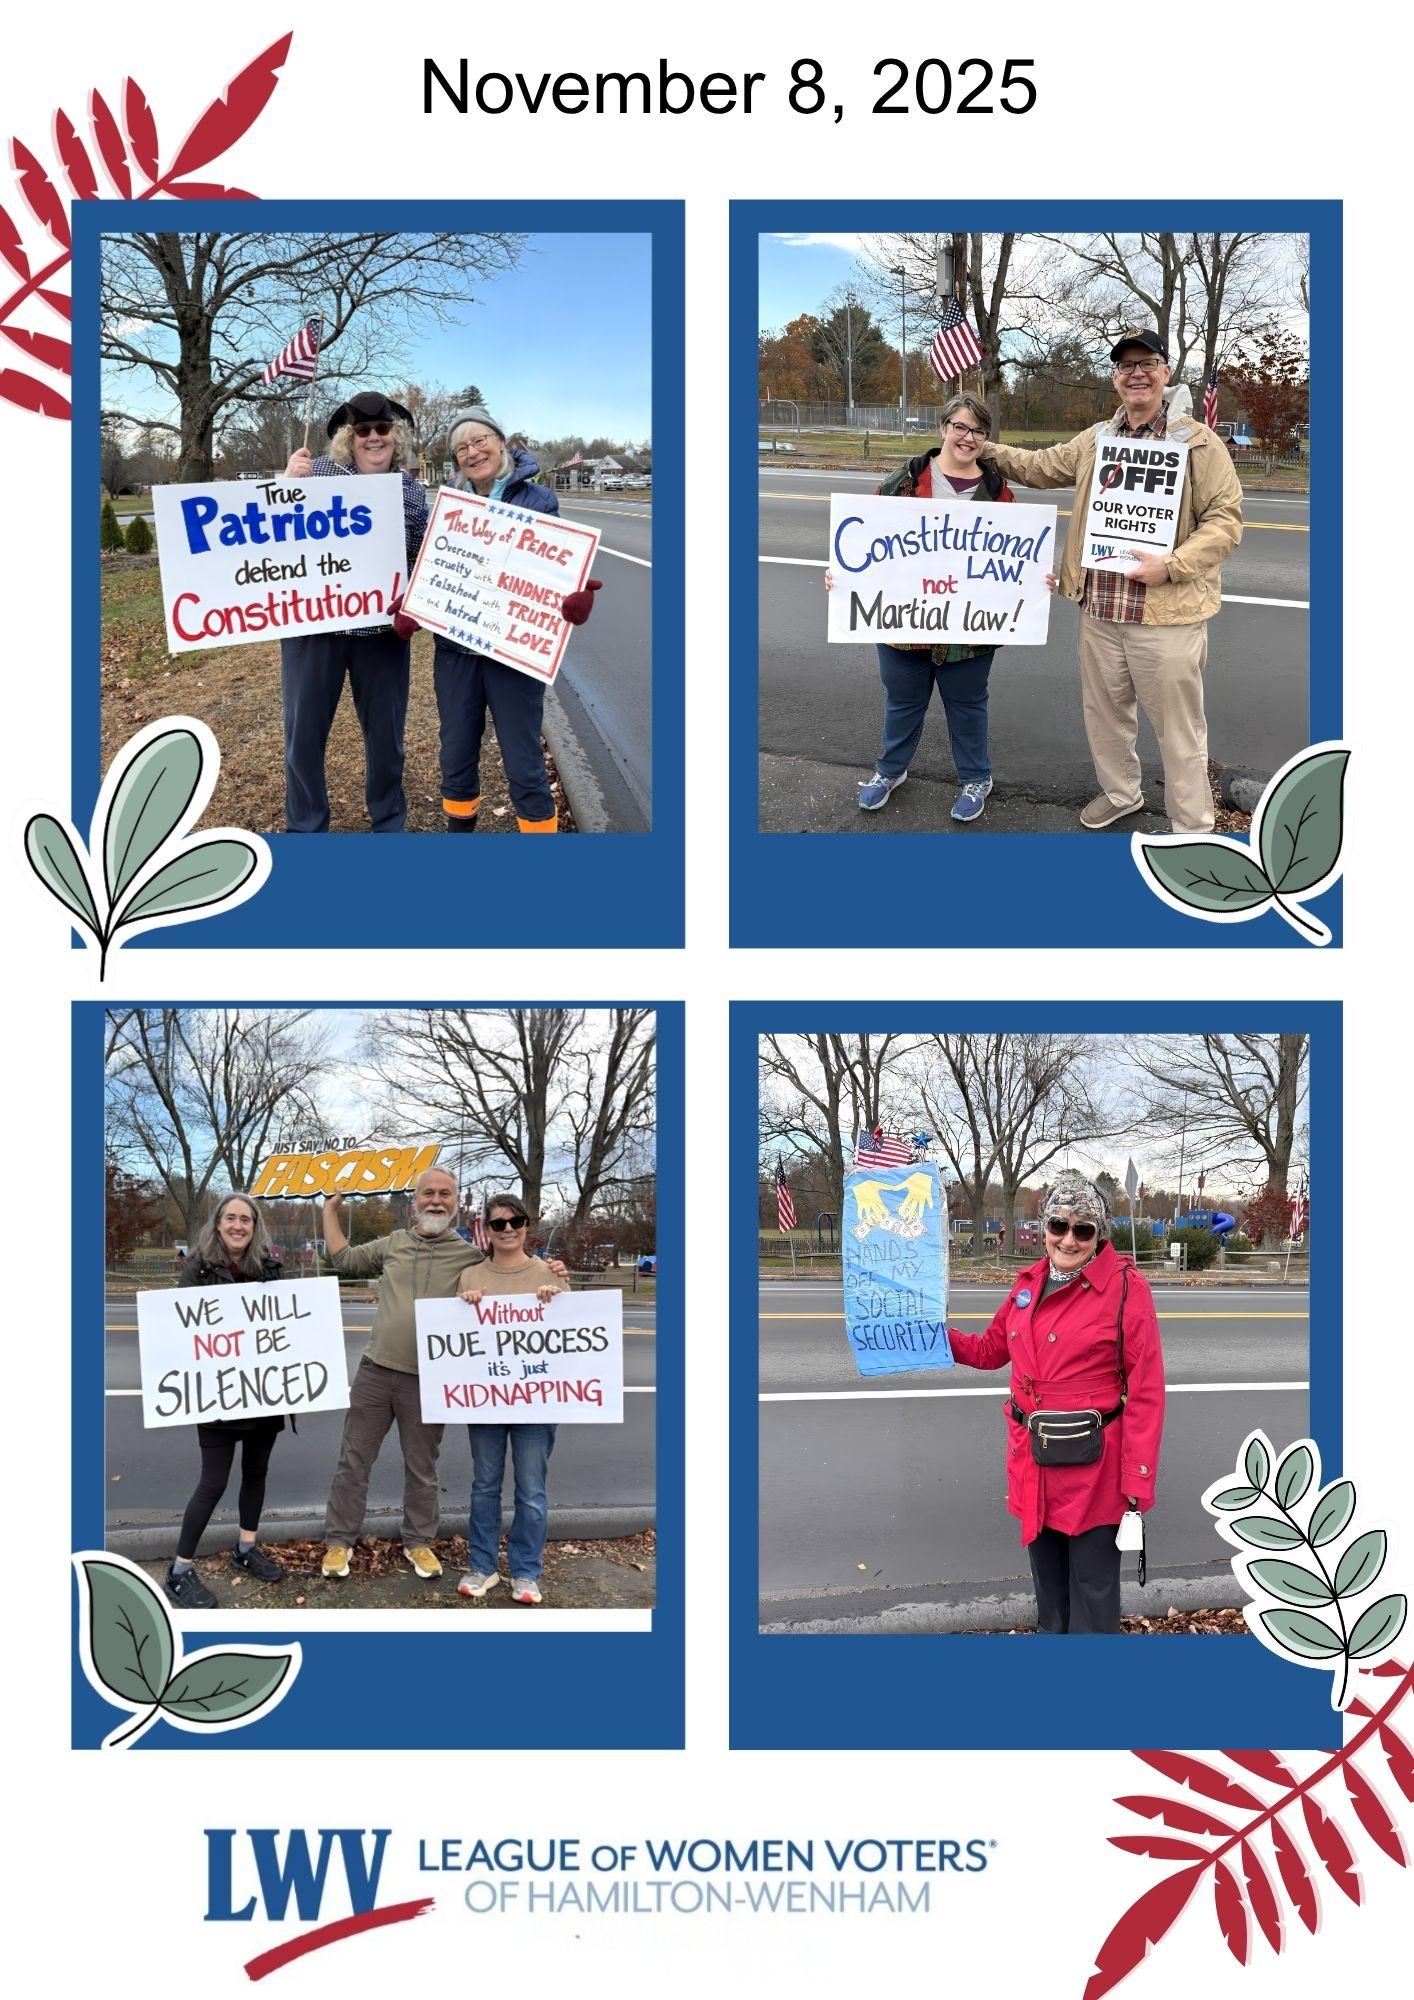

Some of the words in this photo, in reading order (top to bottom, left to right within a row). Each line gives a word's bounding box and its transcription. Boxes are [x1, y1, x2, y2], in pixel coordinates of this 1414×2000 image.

[1101, 446, 1180, 468] HANDS
[256, 482, 306, 506] True
[1099, 462, 1178, 496] OFF!
[180, 495, 372, 554] Patriots
[1092, 500, 1123, 516] OUR
[1126, 504, 1174, 521] VOTER
[1104, 516, 1157, 534] RIGHTS
[444, 509, 469, 533] The
[471, 516, 497, 545] Way
[498, 527, 515, 544] of
[515, 528, 574, 566] PEACE
[834, 513, 1052, 573] Constitutional
[1091, 543, 1115, 557] LWV
[235, 554, 306, 586] defend
[317, 552, 352, 576] the
[474, 573, 494, 585] with
[967, 555, 1025, 585] LAW,
[922, 575, 959, 595] not
[482, 600, 500, 611] with
[507, 600, 562, 636] TRUTH
[850, 590, 951, 632] Martial
[444, 600, 481, 625] hatred
[482, 620, 502, 634] with
[505, 624, 553, 656] LOVE
[271, 1141, 297, 1155] JUST
[323, 1137, 340, 1151] NO
[342, 1136, 357, 1150] TO
[250, 1144, 442, 1197] FASCISM
[846, 1239, 918, 1266] HANDS
[892, 1260, 924, 1280] MY
[175, 1298, 224, 1328] WE
[241, 1293, 311, 1322] WILL
[474, 1301, 545, 1325] Without
[855, 1288, 930, 1321] SOCIAL
[194, 1330, 245, 1360] NOT
[256, 1327, 290, 1355] BE
[427, 1331, 485, 1360] DUE
[497, 1326, 609, 1356] PROCESS
[488, 1361, 510, 1377] it's
[520, 1360, 549, 1380] just
[155, 1361, 328, 1417] SILENCED
[444, 1379, 603, 1408] KIDNAPPING
